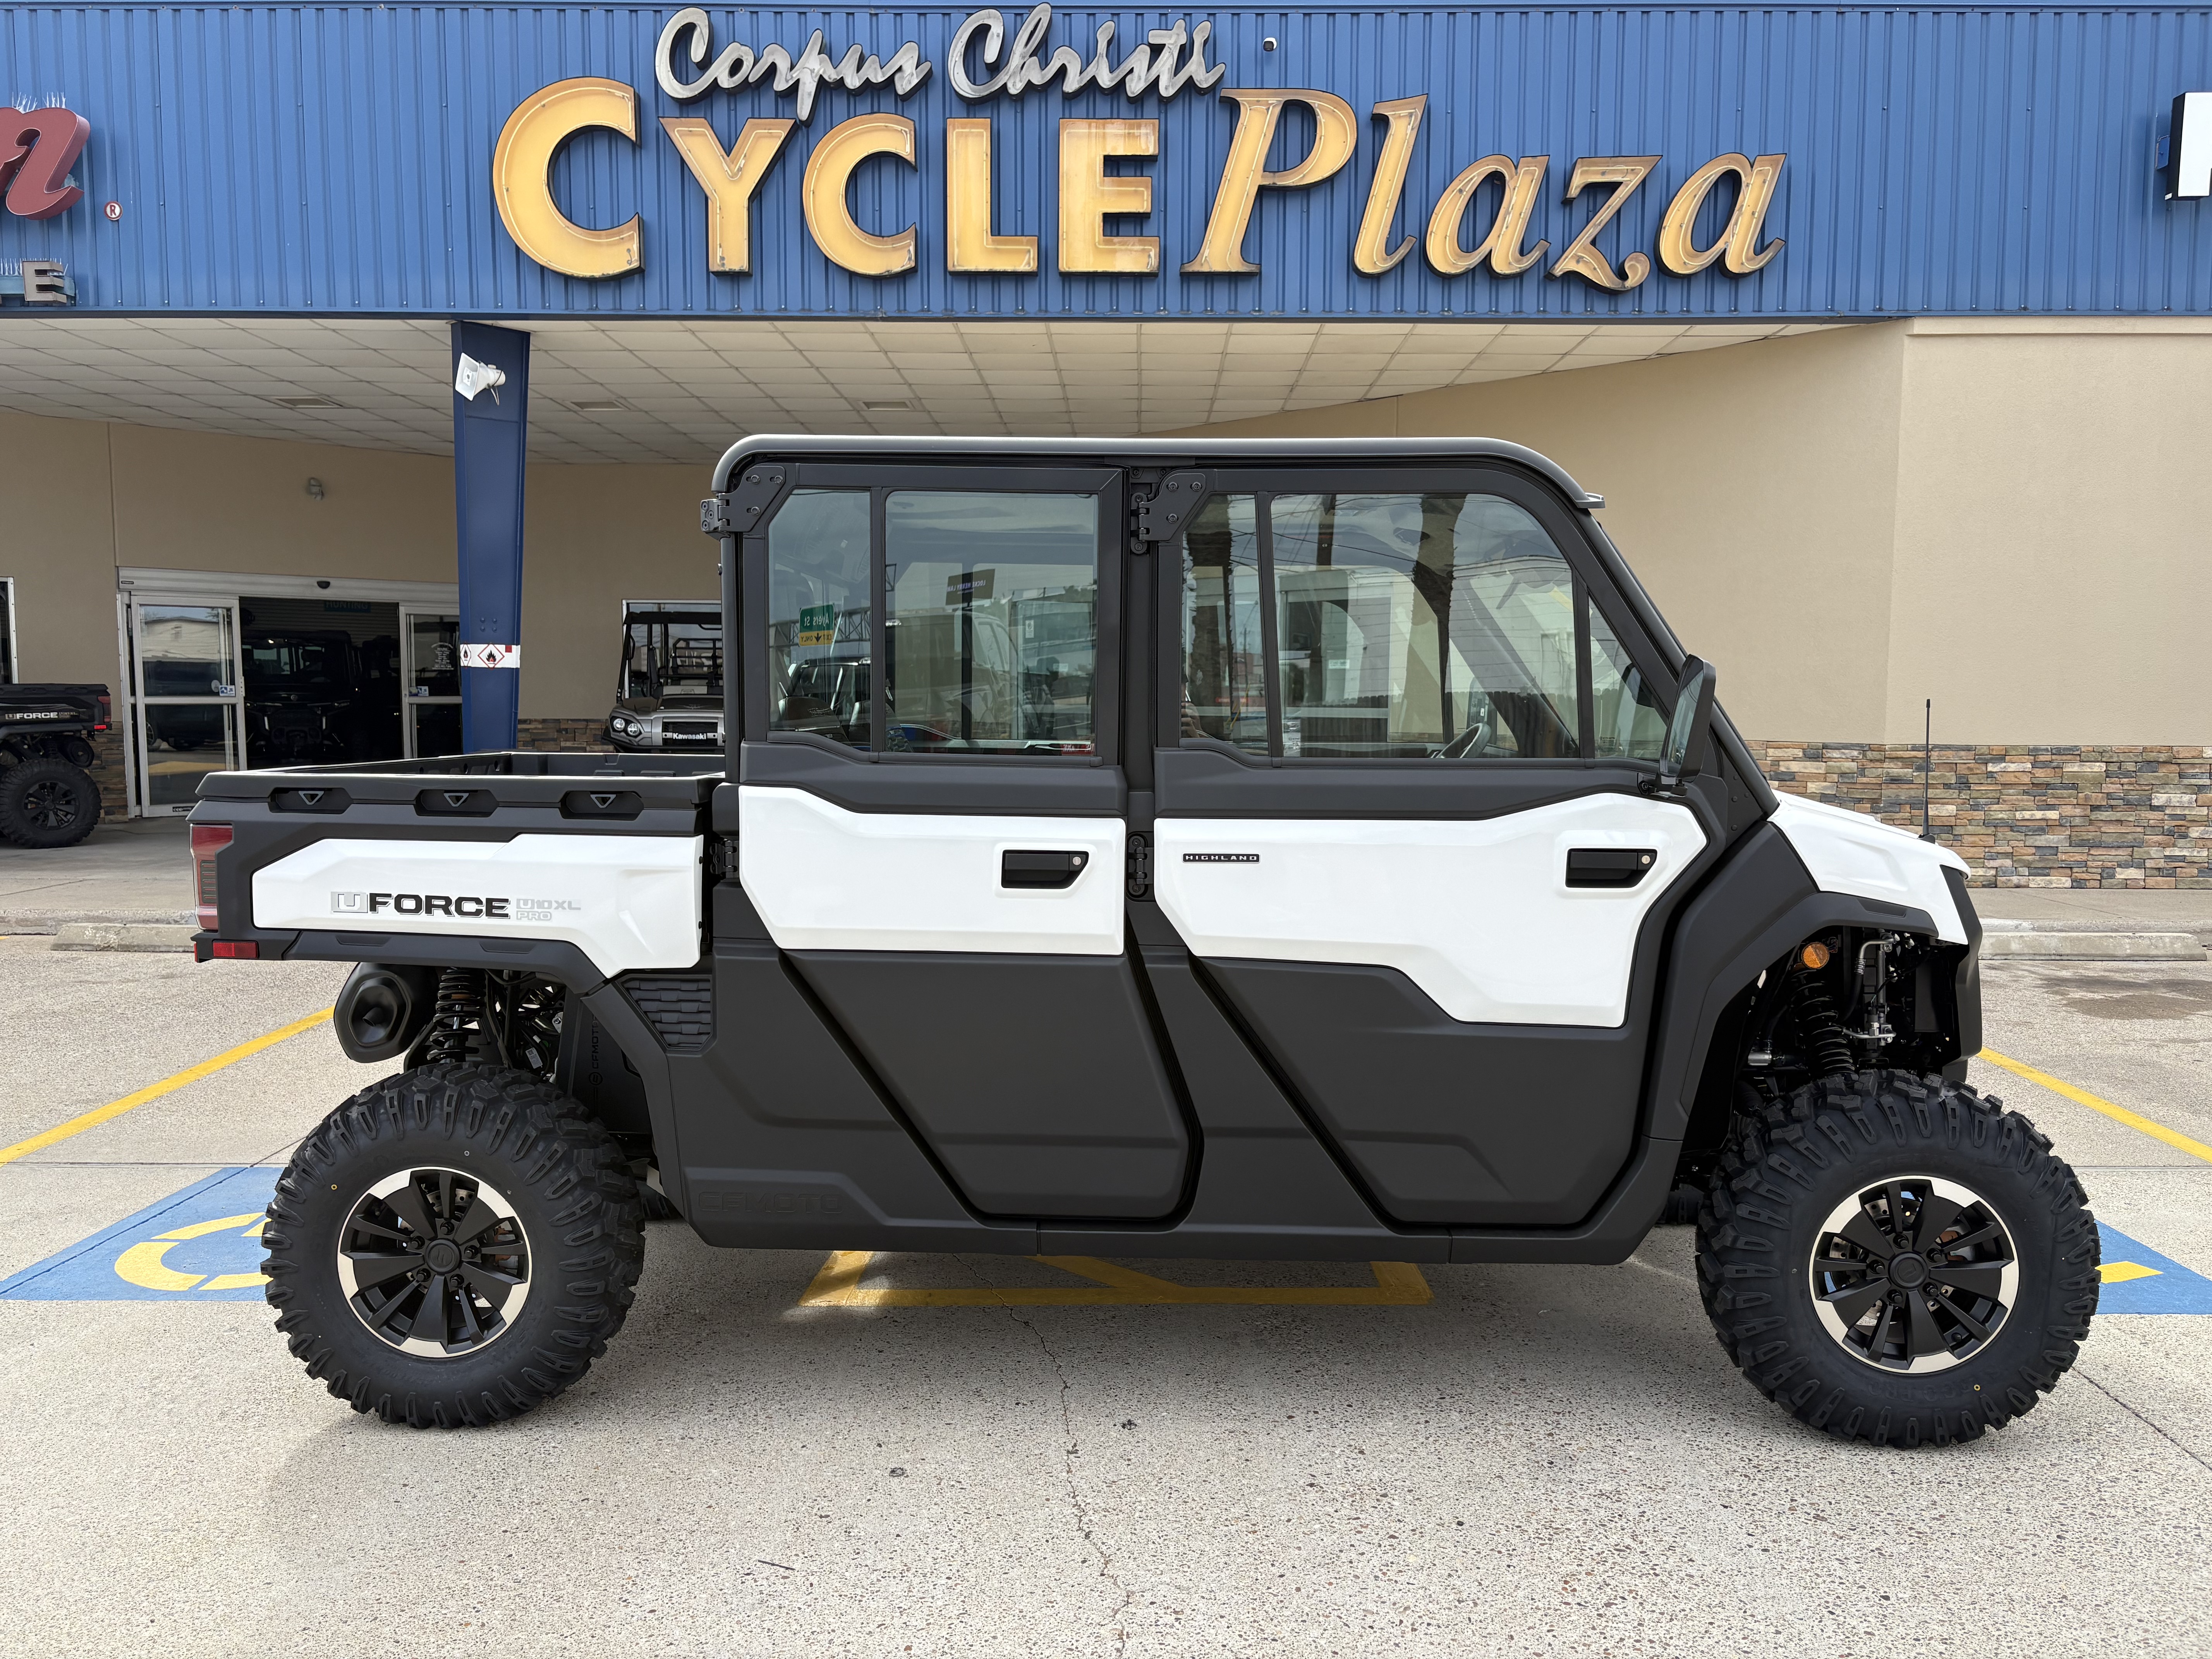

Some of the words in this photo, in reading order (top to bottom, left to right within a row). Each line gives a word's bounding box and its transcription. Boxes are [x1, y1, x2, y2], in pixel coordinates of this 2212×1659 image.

[655, 7, 933, 127] Corpus
[948, 2, 1226, 105] Christi
[492, 76, 1159, 280] CYCLE
[1180, 88, 1787, 295] Plaza
[516, 910, 552, 921] PRO
[698, 1191, 844, 1214] CFMOTO
